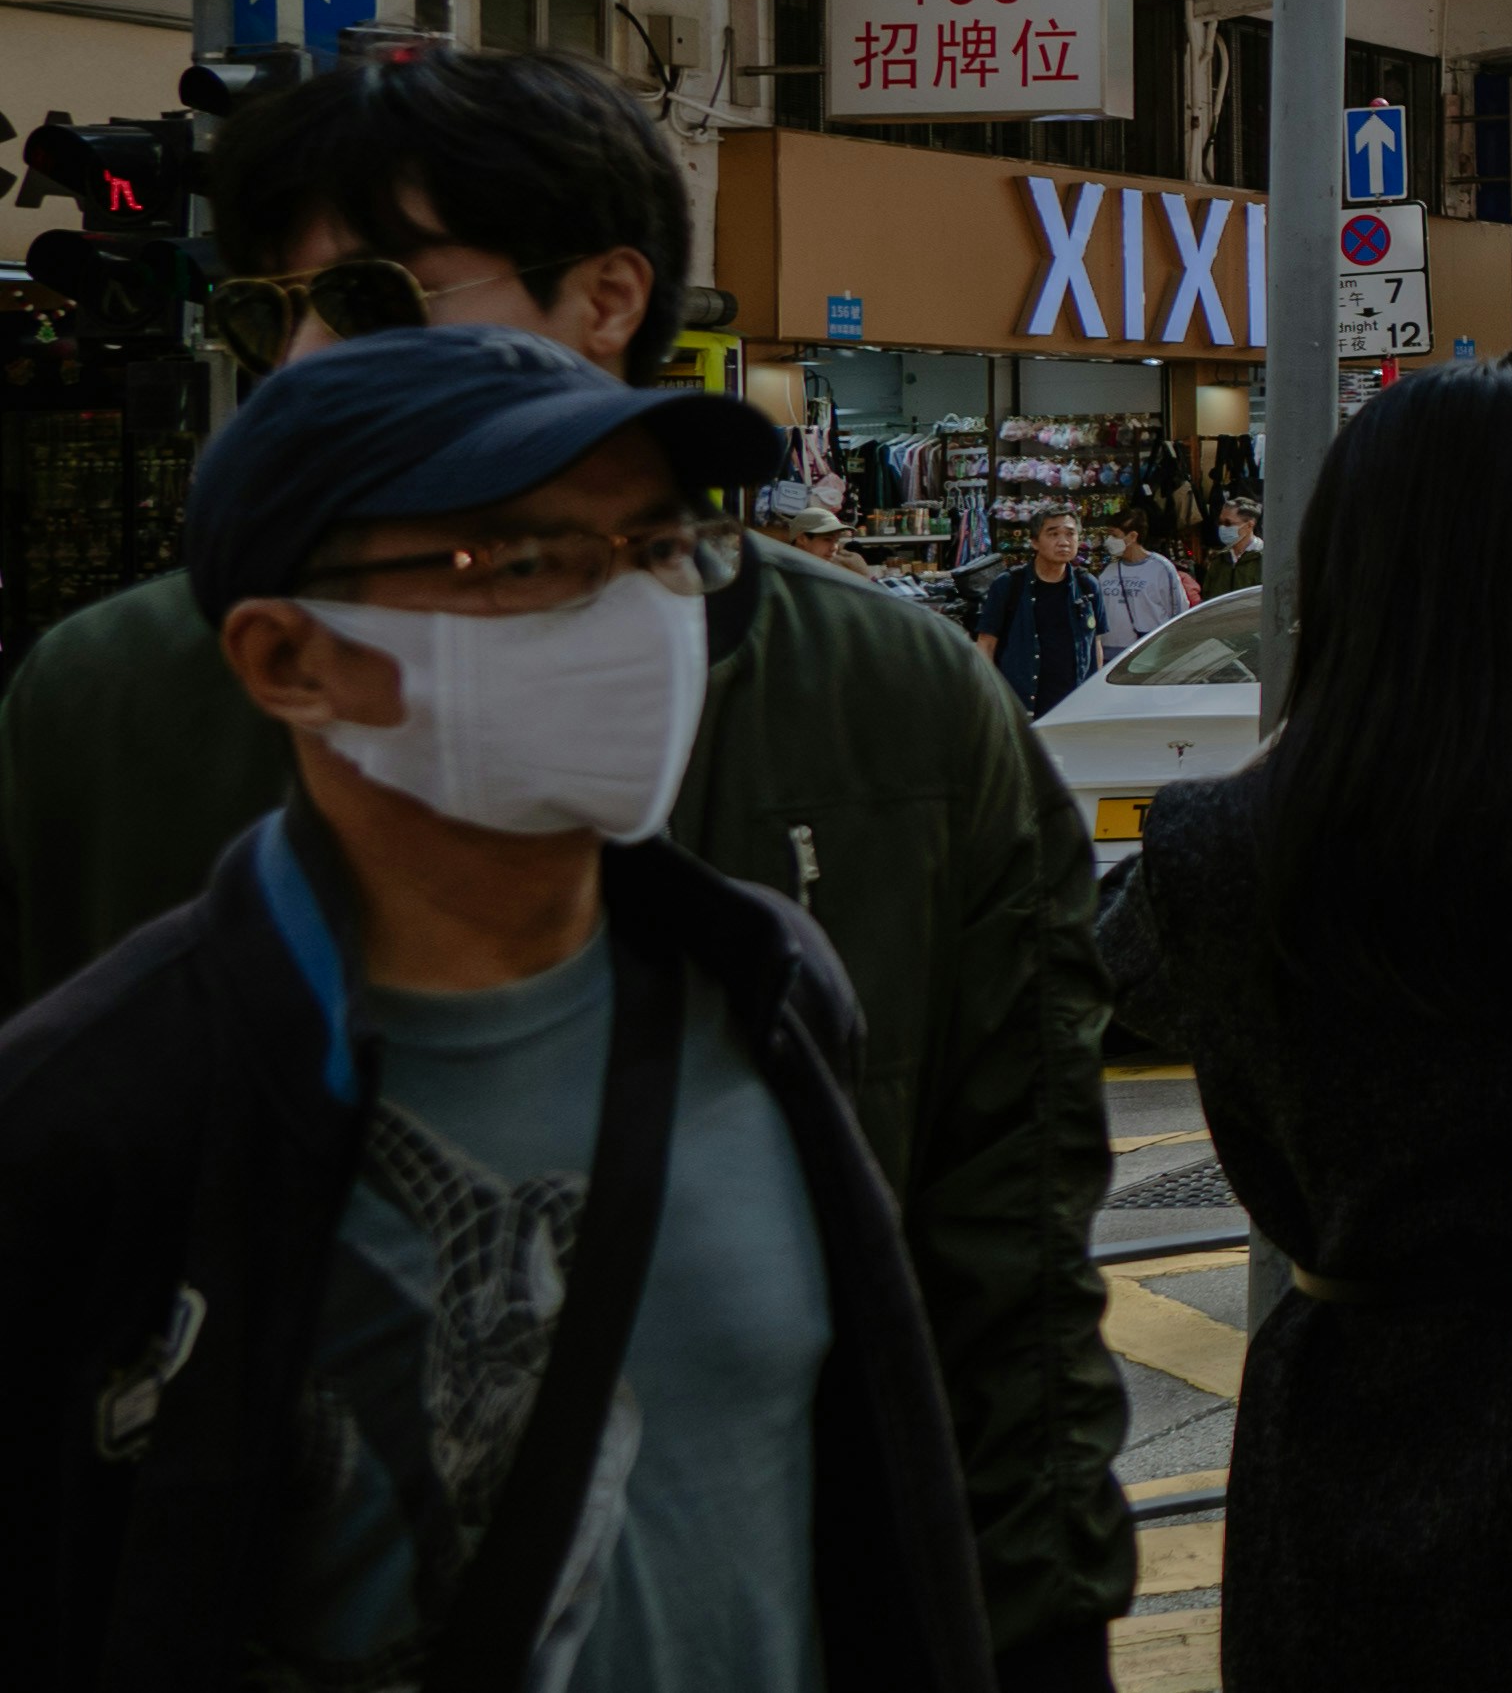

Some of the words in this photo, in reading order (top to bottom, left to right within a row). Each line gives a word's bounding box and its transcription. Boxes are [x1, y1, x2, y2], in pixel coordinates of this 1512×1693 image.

[853, 19, 1079, 89] 招牌位
[1384, 277, 1403, 304] 7
[1387, 321, 1421, 348] 12
